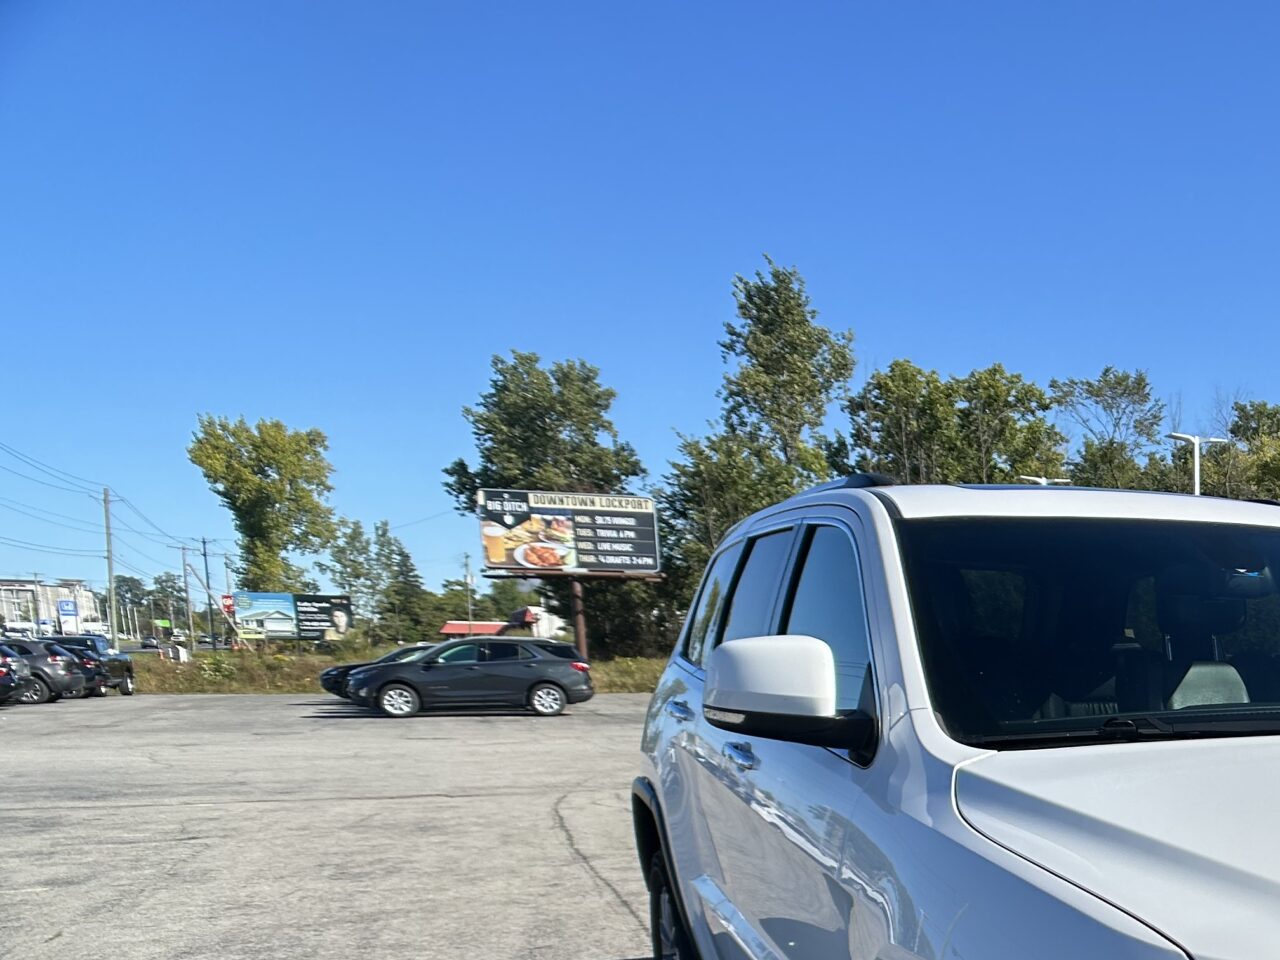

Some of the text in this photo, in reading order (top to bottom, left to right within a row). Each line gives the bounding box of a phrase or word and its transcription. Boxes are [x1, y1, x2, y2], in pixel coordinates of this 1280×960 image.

[486, 501, 528, 512] BIG DITCH
[533, 494, 650, 510] DOWNTOWN LOCKPORT
[597, 542, 611, 550] LIVE
